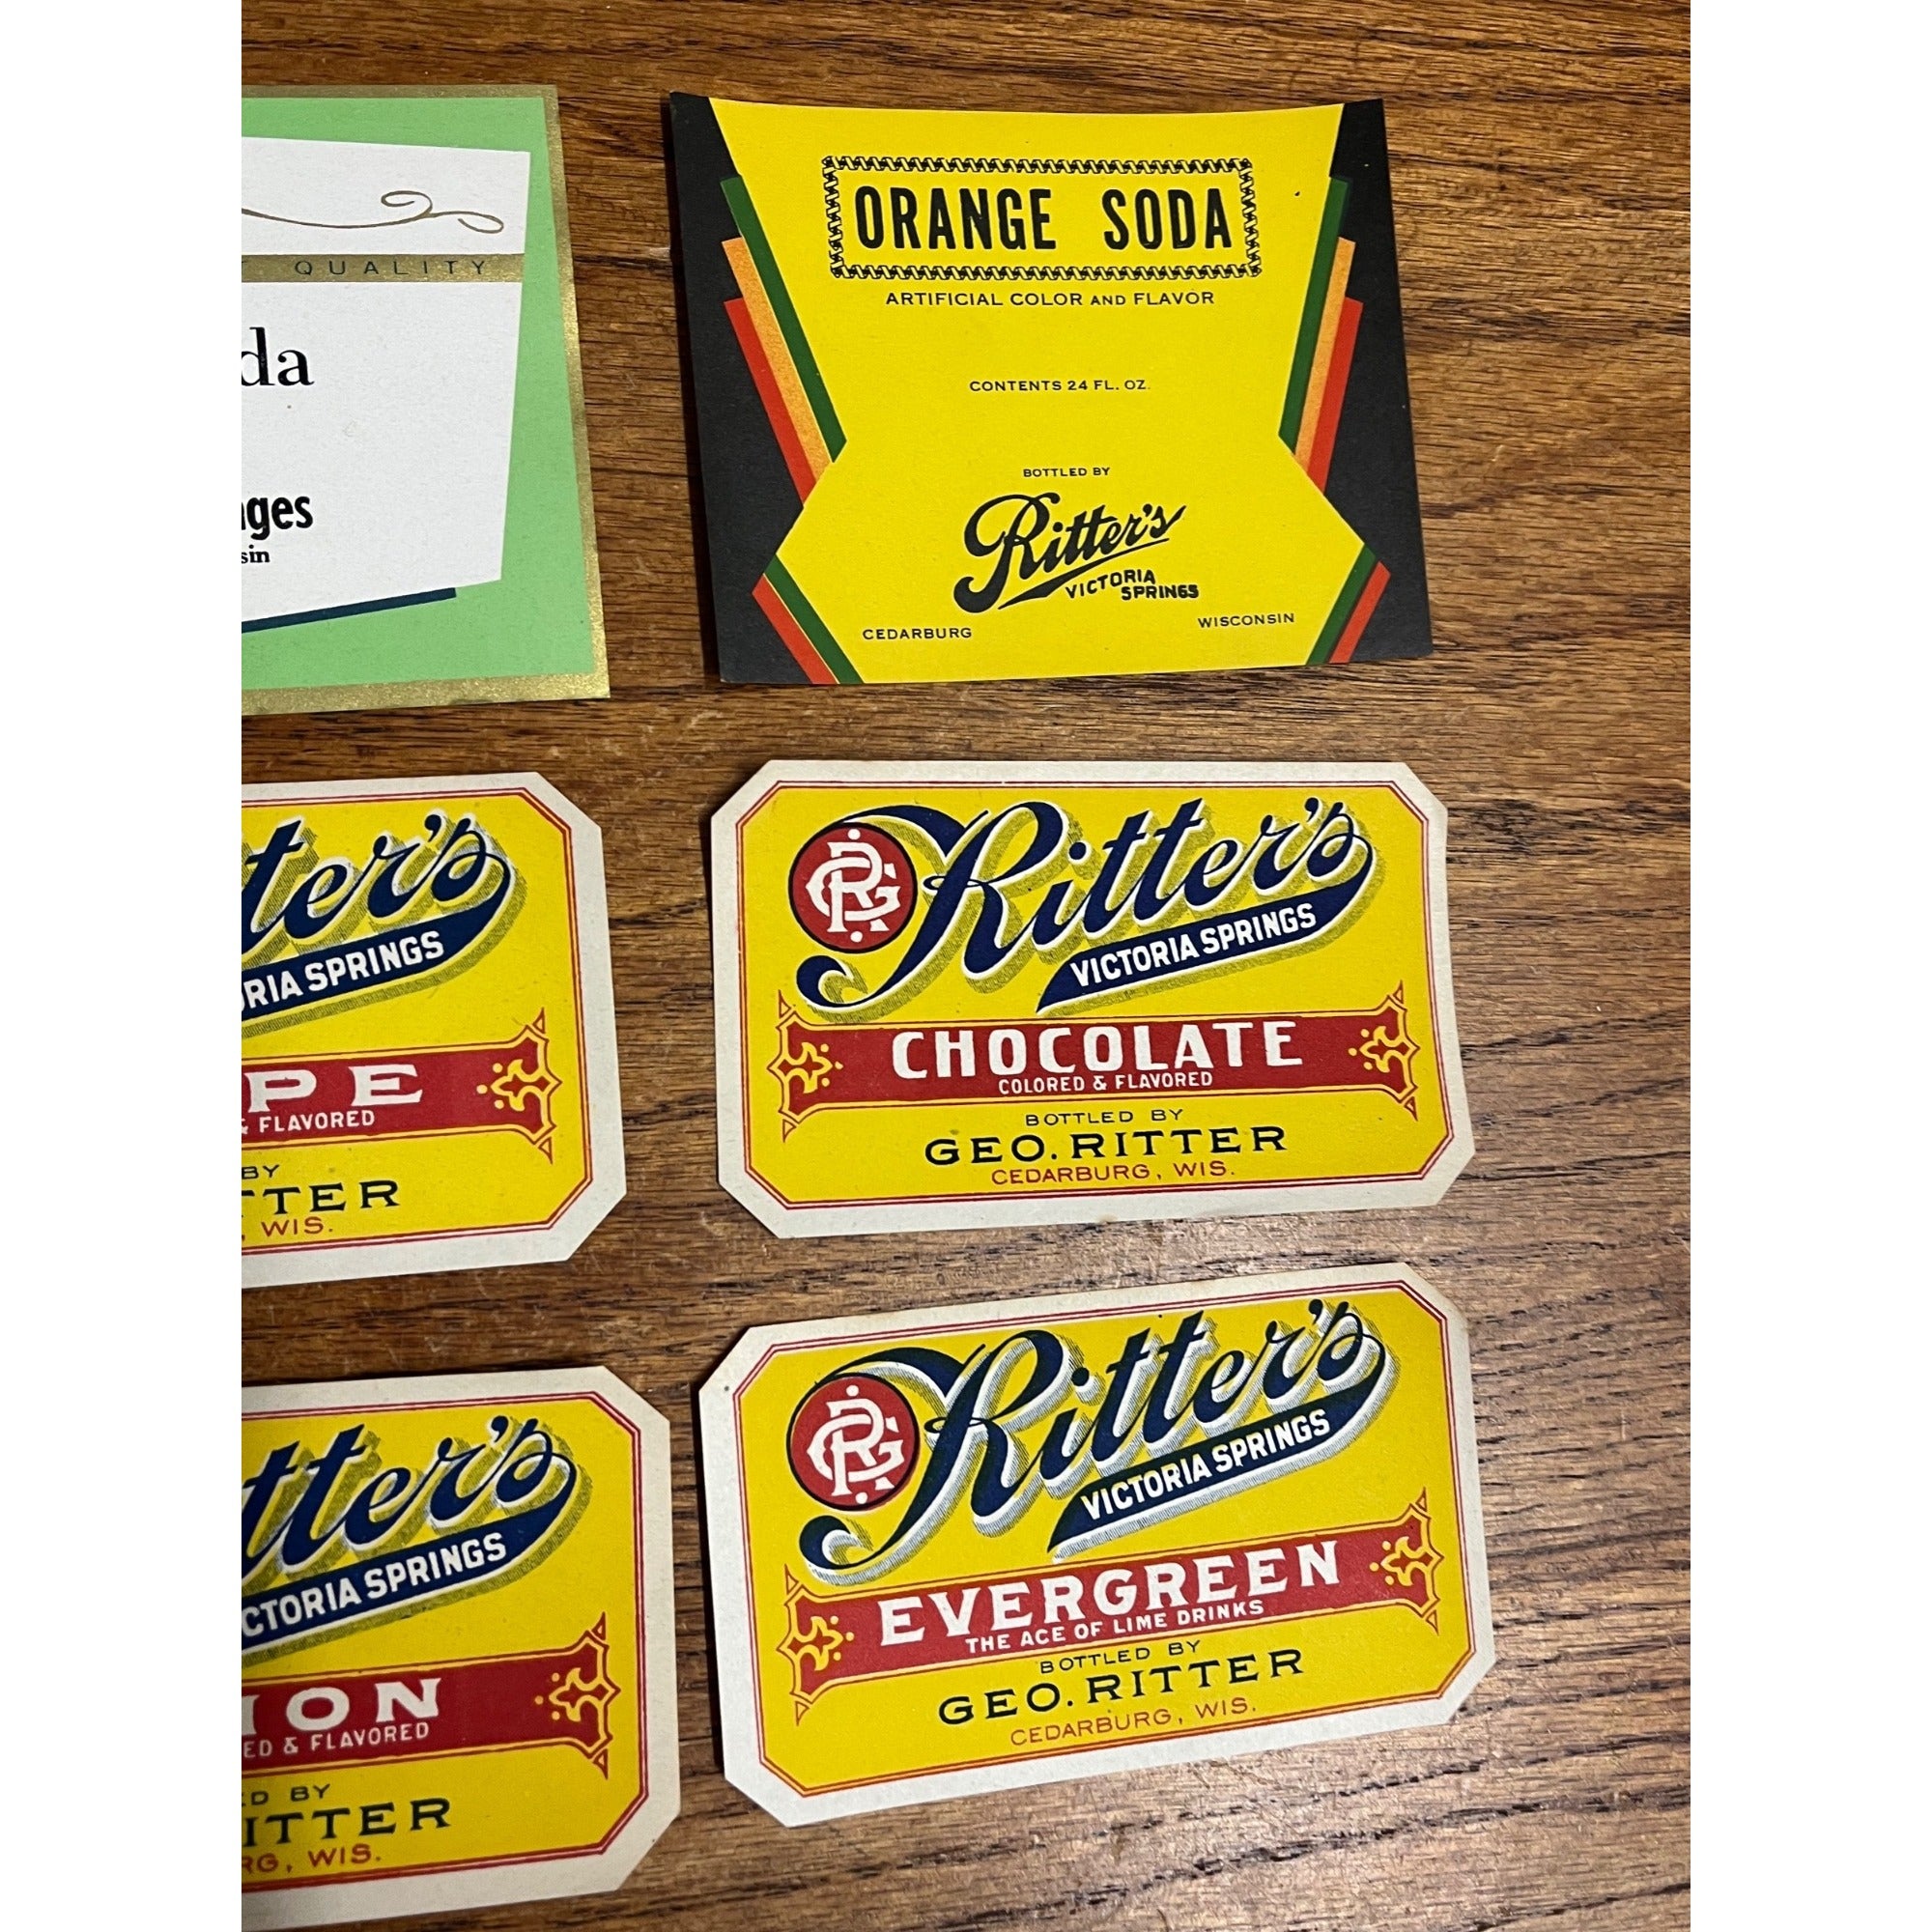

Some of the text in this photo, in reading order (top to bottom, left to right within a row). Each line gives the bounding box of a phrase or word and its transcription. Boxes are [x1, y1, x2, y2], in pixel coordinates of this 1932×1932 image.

[854, 185, 1233, 251] ORANGE SODA
[294, 260, 486, 276] QUALITY
[885, 291, 1215, 306] ARTIFICIAL COLOR AND FLAVOR
[969, 380, 1063, 392] CONTENTS
[1066, 380, 1089, 391] 24
[1094, 380, 1121, 391] FL.
[1022, 467, 1111, 478] BOTTLED BY
[242, 496, 314, 540] ges
[952, 492, 1187, 613] Ritter's
[1064, 569, 1156, 599] VICTORIA
[1121, 583, 1200, 601] SPRINGS
[862, 627, 973, 640] CEDARBURG
[1197, 612, 1296, 629] WISCONSIN
[796, 797, 1374, 1007] Ritter's
[1069, 902, 1318, 987] VICTORIA SPRINGS
[242, 929, 444, 1012] RIA SPRINGS
[892, 1020, 1303, 1080] CHOCOLATE
[998, 1070, 1213, 1094] COLORED & FLAVORED
[259, 1110, 376, 1133] FLAVORED
[1025, 1108, 1184, 1126] BOTTLED BY
[924, 1125, 1288, 1166] GEO. RITTER
[242, 1164, 280, 1179] BY
[991, 1159, 1235, 1185] CEDARBURG, WIS.
[260, 1216, 334, 1237] WIS.
[799, 1298, 1387, 1570] Ritter's
[1081, 1408, 1331, 1520] VICTORIA SPRINGS
[363, 1531, 507, 1599] SPRINGS
[876, 1539, 1341, 1647] EVERGREEN
[965, 1599, 1264, 1654] THE ACE OF LIME DRINKS
[1040, 1639, 1201, 1674] BOTTLED BY
[938, 1648, 1305, 1725] GEO. RITTER
[1010, 1696, 1258, 1746] CEDARBURG, WIS.
[242, 1721, 430, 1758] ED & FLAVORED
[290, 1783, 331, 1802] BY
[242, 1797, 452, 1848] ITTER
[307, 1842, 382, 1867] WIS.
